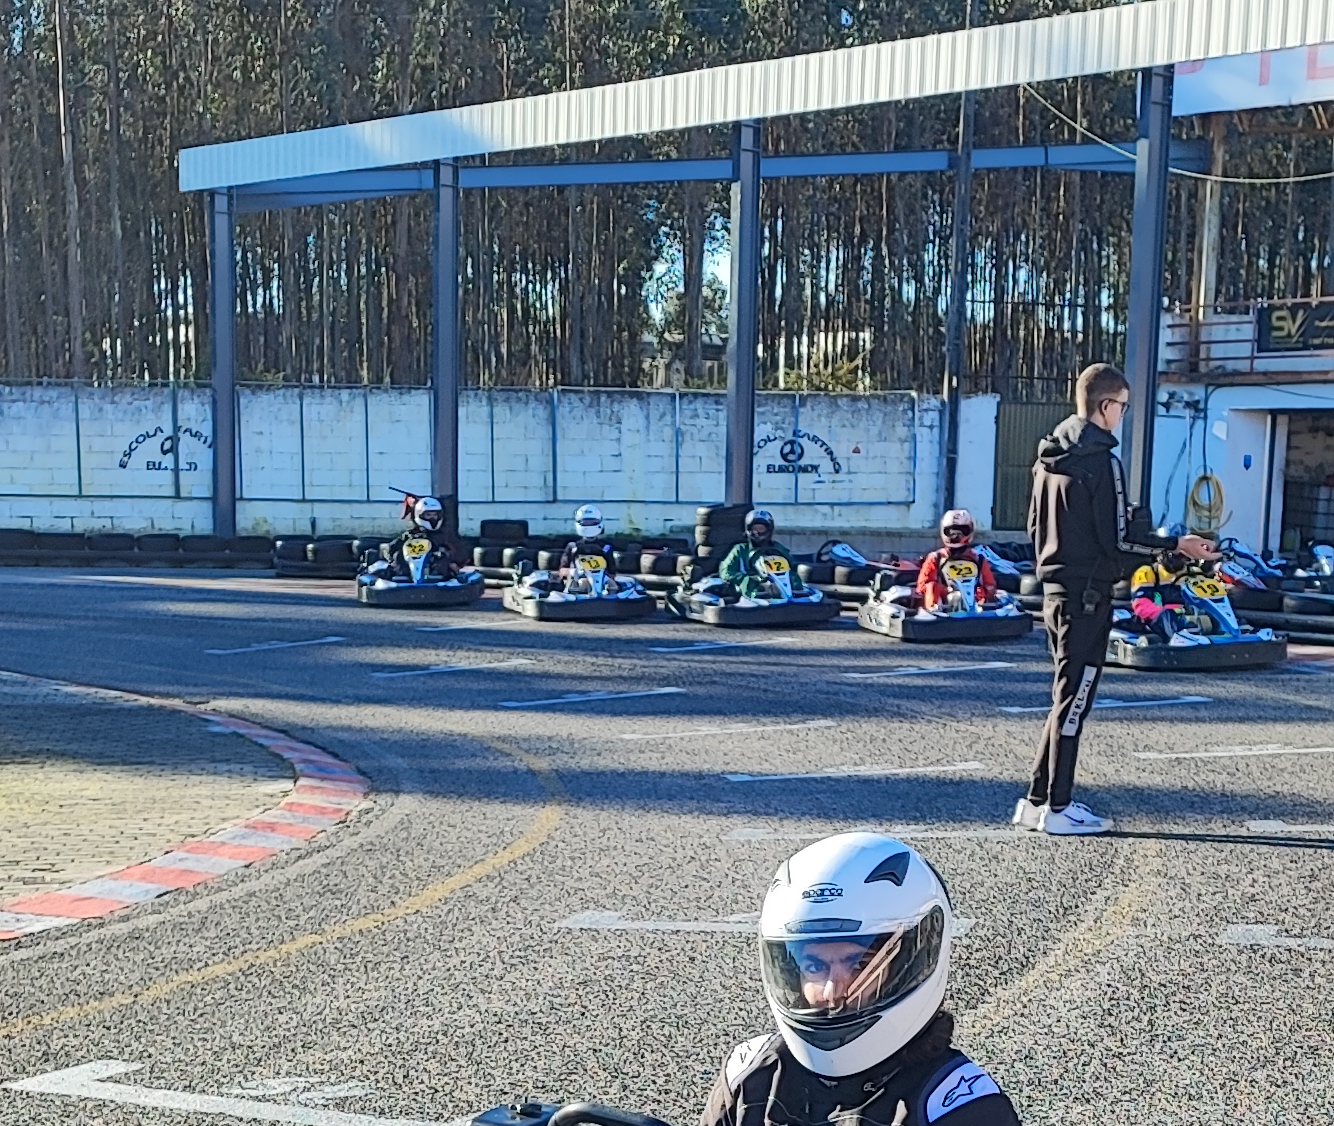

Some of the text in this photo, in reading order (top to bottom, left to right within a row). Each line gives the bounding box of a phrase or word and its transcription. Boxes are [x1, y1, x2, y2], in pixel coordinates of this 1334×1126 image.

[118, 426, 165, 470] ESCOLA
[766, 463, 821, 474] EURONDY
[802, 887, 844, 900] sparco
